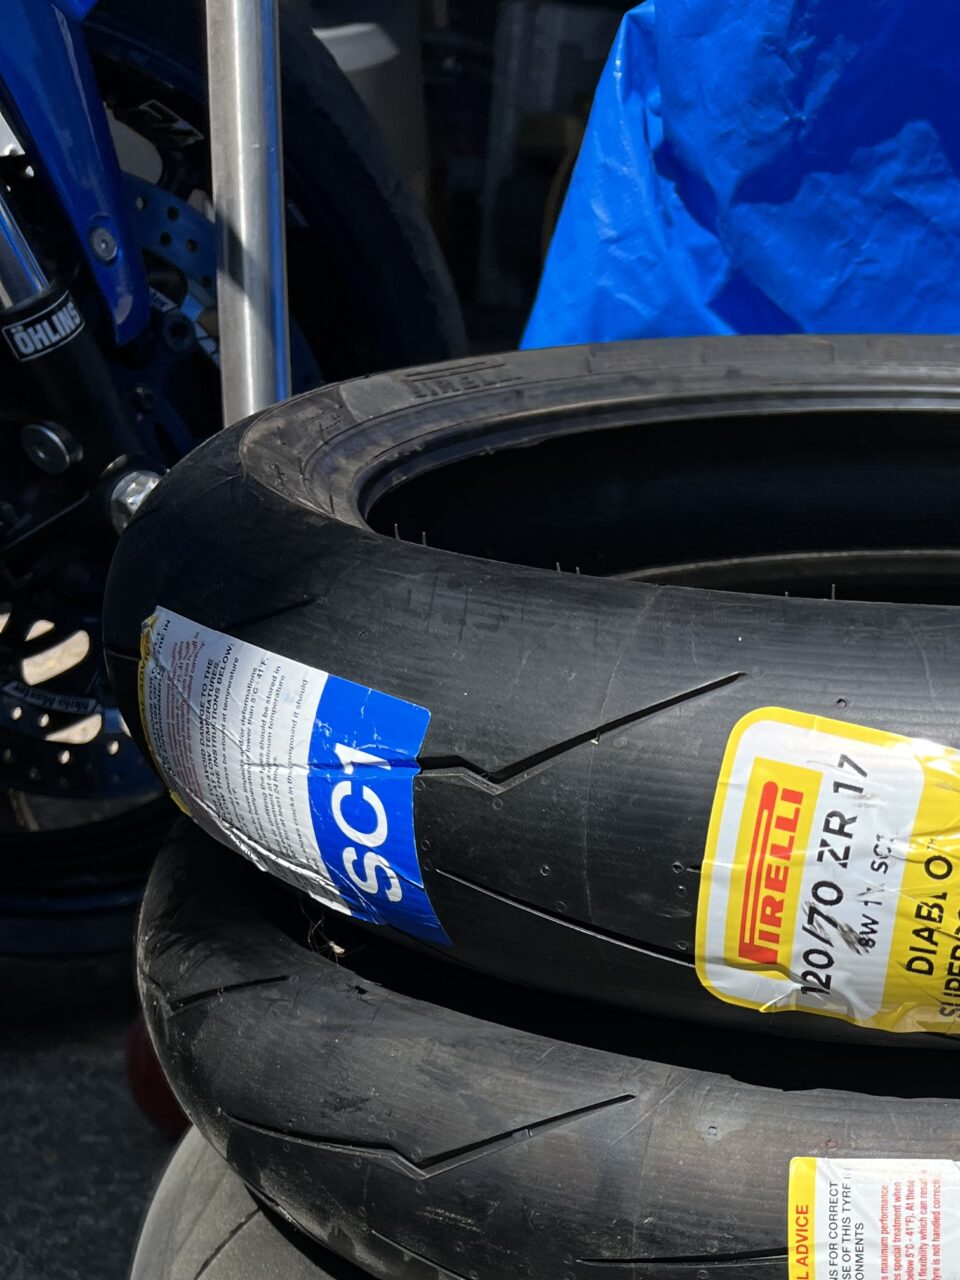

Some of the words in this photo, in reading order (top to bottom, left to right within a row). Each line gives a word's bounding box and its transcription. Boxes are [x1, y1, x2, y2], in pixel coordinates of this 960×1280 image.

[11, 302, 81, 354] ÖHLINS
[204, 659, 213, 675] THE
[201, 683, 207, 698] TO
[222, 658, 238, 710] temperature
[240, 668, 257, 726] deformations
[264, 675, 277, 704] stored
[296, 679, 308, 709] should
[200, 749, 212, 778] AVOID
[205, 750, 215, 776] LOW
[833, 753, 868, 795] 17
[331, 743, 402, 902] SC1
[816, 810, 858, 869] ZR
[738, 781, 804, 964] PIRELLI
[800, 880, 844, 996] 120/70
[893, 1182, 901, 1202] when
[905, 1180, 914, 1200] these
[829, 1181, 838, 1239] CORRECT
[880, 1185, 889, 1234] performance
[893, 1205, 901, 1242] treatment
[796, 1204, 808, 1266] ADVICE
[842, 1217, 851, 1242] THIS
[918, 1217, 927, 1240] which
[932, 1212, 940, 1241] handled
[829, 1242, 838, 1266] FOR
[842, 1246, 851, 1262] OF
[880, 1237, 888, 1273] maximum
[892, 1245, 902, 1271] special
[918, 1243, 928, 1277] flexibility
[932, 1244, 940, 1256] not
[932, 1267, 942, 1280] tyre
